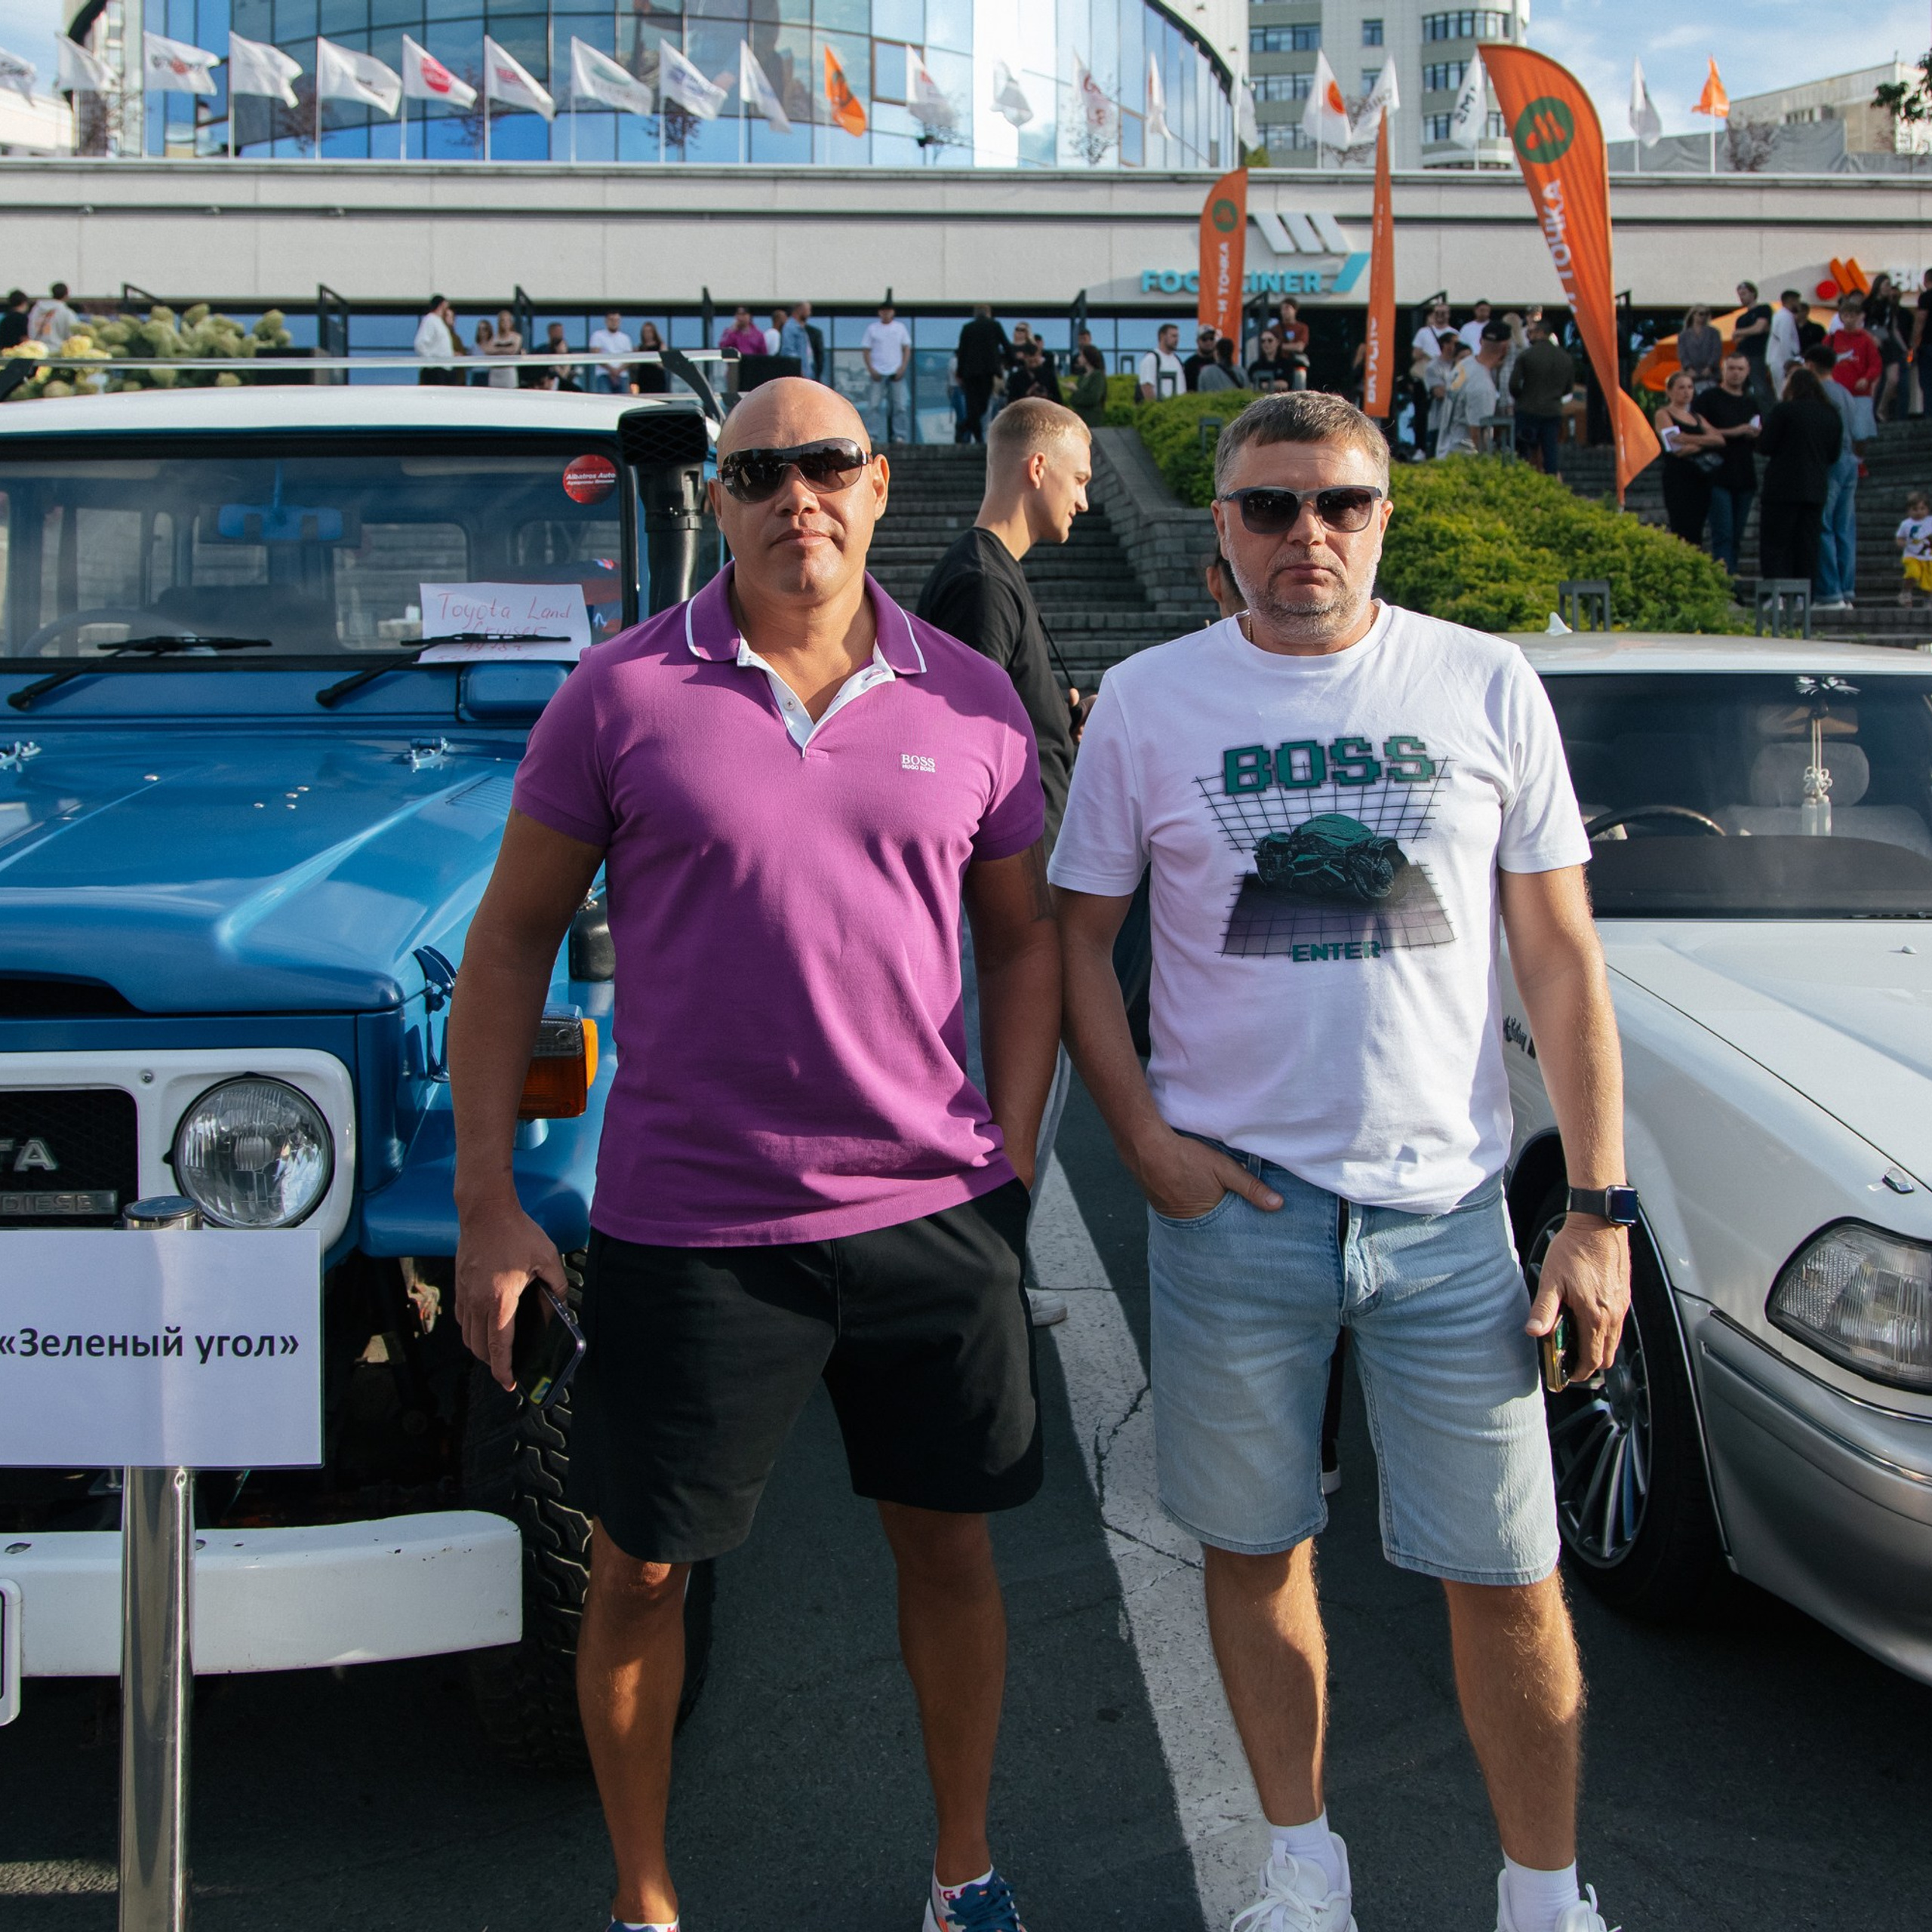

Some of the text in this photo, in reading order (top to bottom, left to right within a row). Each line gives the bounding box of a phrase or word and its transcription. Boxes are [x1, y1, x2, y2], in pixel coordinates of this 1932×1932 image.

[1141, 269, 1321, 294] FOOINER
[437, 592, 572, 630] Toyota Land
[901, 753, 936, 768] BOSS
[1223, 735, 1437, 797] BOSS
[1292, 940, 1381, 963] ENTER
[0, 1326, 300, 1364] «Зеленый угол»
